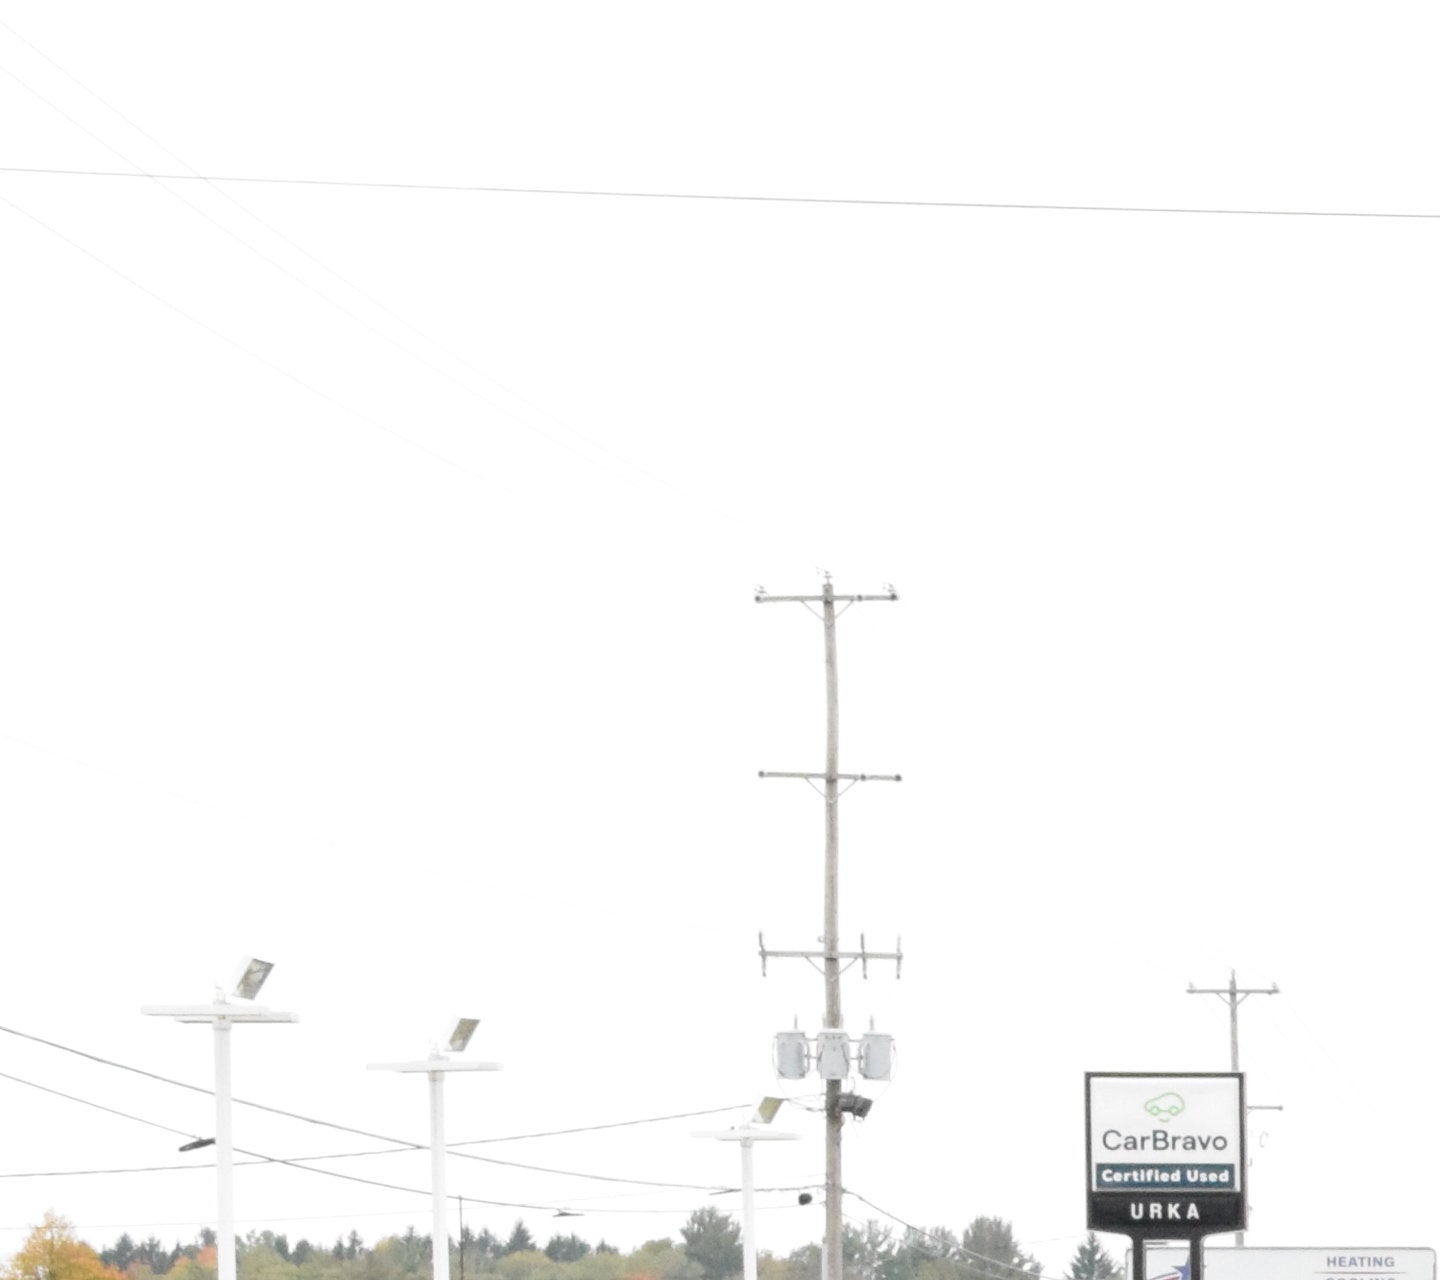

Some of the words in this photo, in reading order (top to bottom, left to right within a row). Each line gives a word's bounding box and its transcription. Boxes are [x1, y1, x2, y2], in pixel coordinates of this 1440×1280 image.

[1102, 1129, 1228, 1151] CarBravo
[1101, 1168, 1181, 1182] Certified
[1186, 1169, 1230, 1182] Used
[1130, 1203, 1200, 1220] URKA
[1326, 1256, 1395, 1268] HEATING
